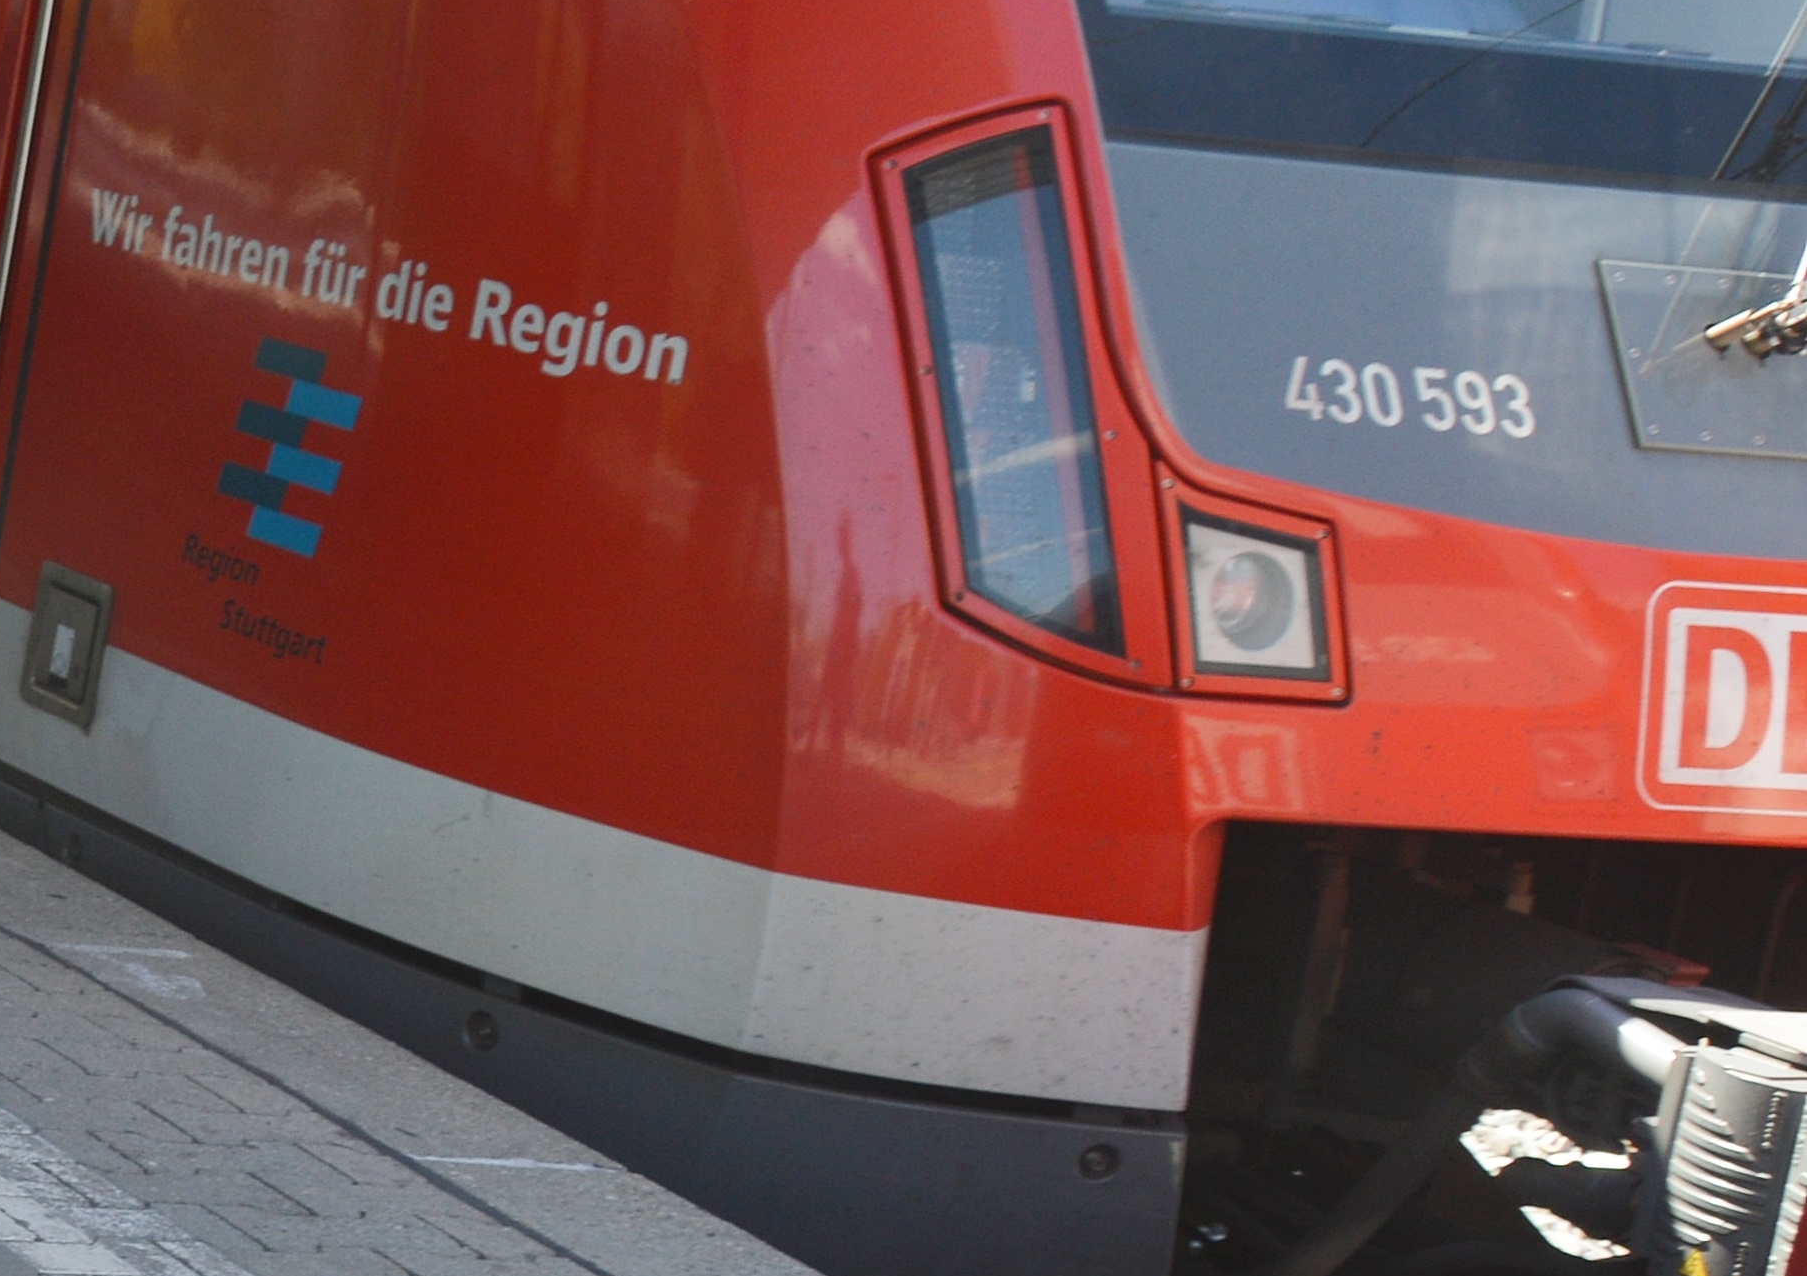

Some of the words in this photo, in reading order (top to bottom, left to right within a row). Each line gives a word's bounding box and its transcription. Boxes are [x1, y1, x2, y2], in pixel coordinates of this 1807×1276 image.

[89, 187, 154, 253] Wir
[161, 205, 291, 290] fahren
[301, 239, 367, 309] für
[375, 261, 454, 333] die
[468, 278, 690, 387] Region
[1286, 357, 1403, 428] 430
[1414, 367, 1536, 439] 593
[180, 532, 261, 588] Region
[218, 598, 327, 665] Stuttgart
[1673, 618, 1807, 781] D
